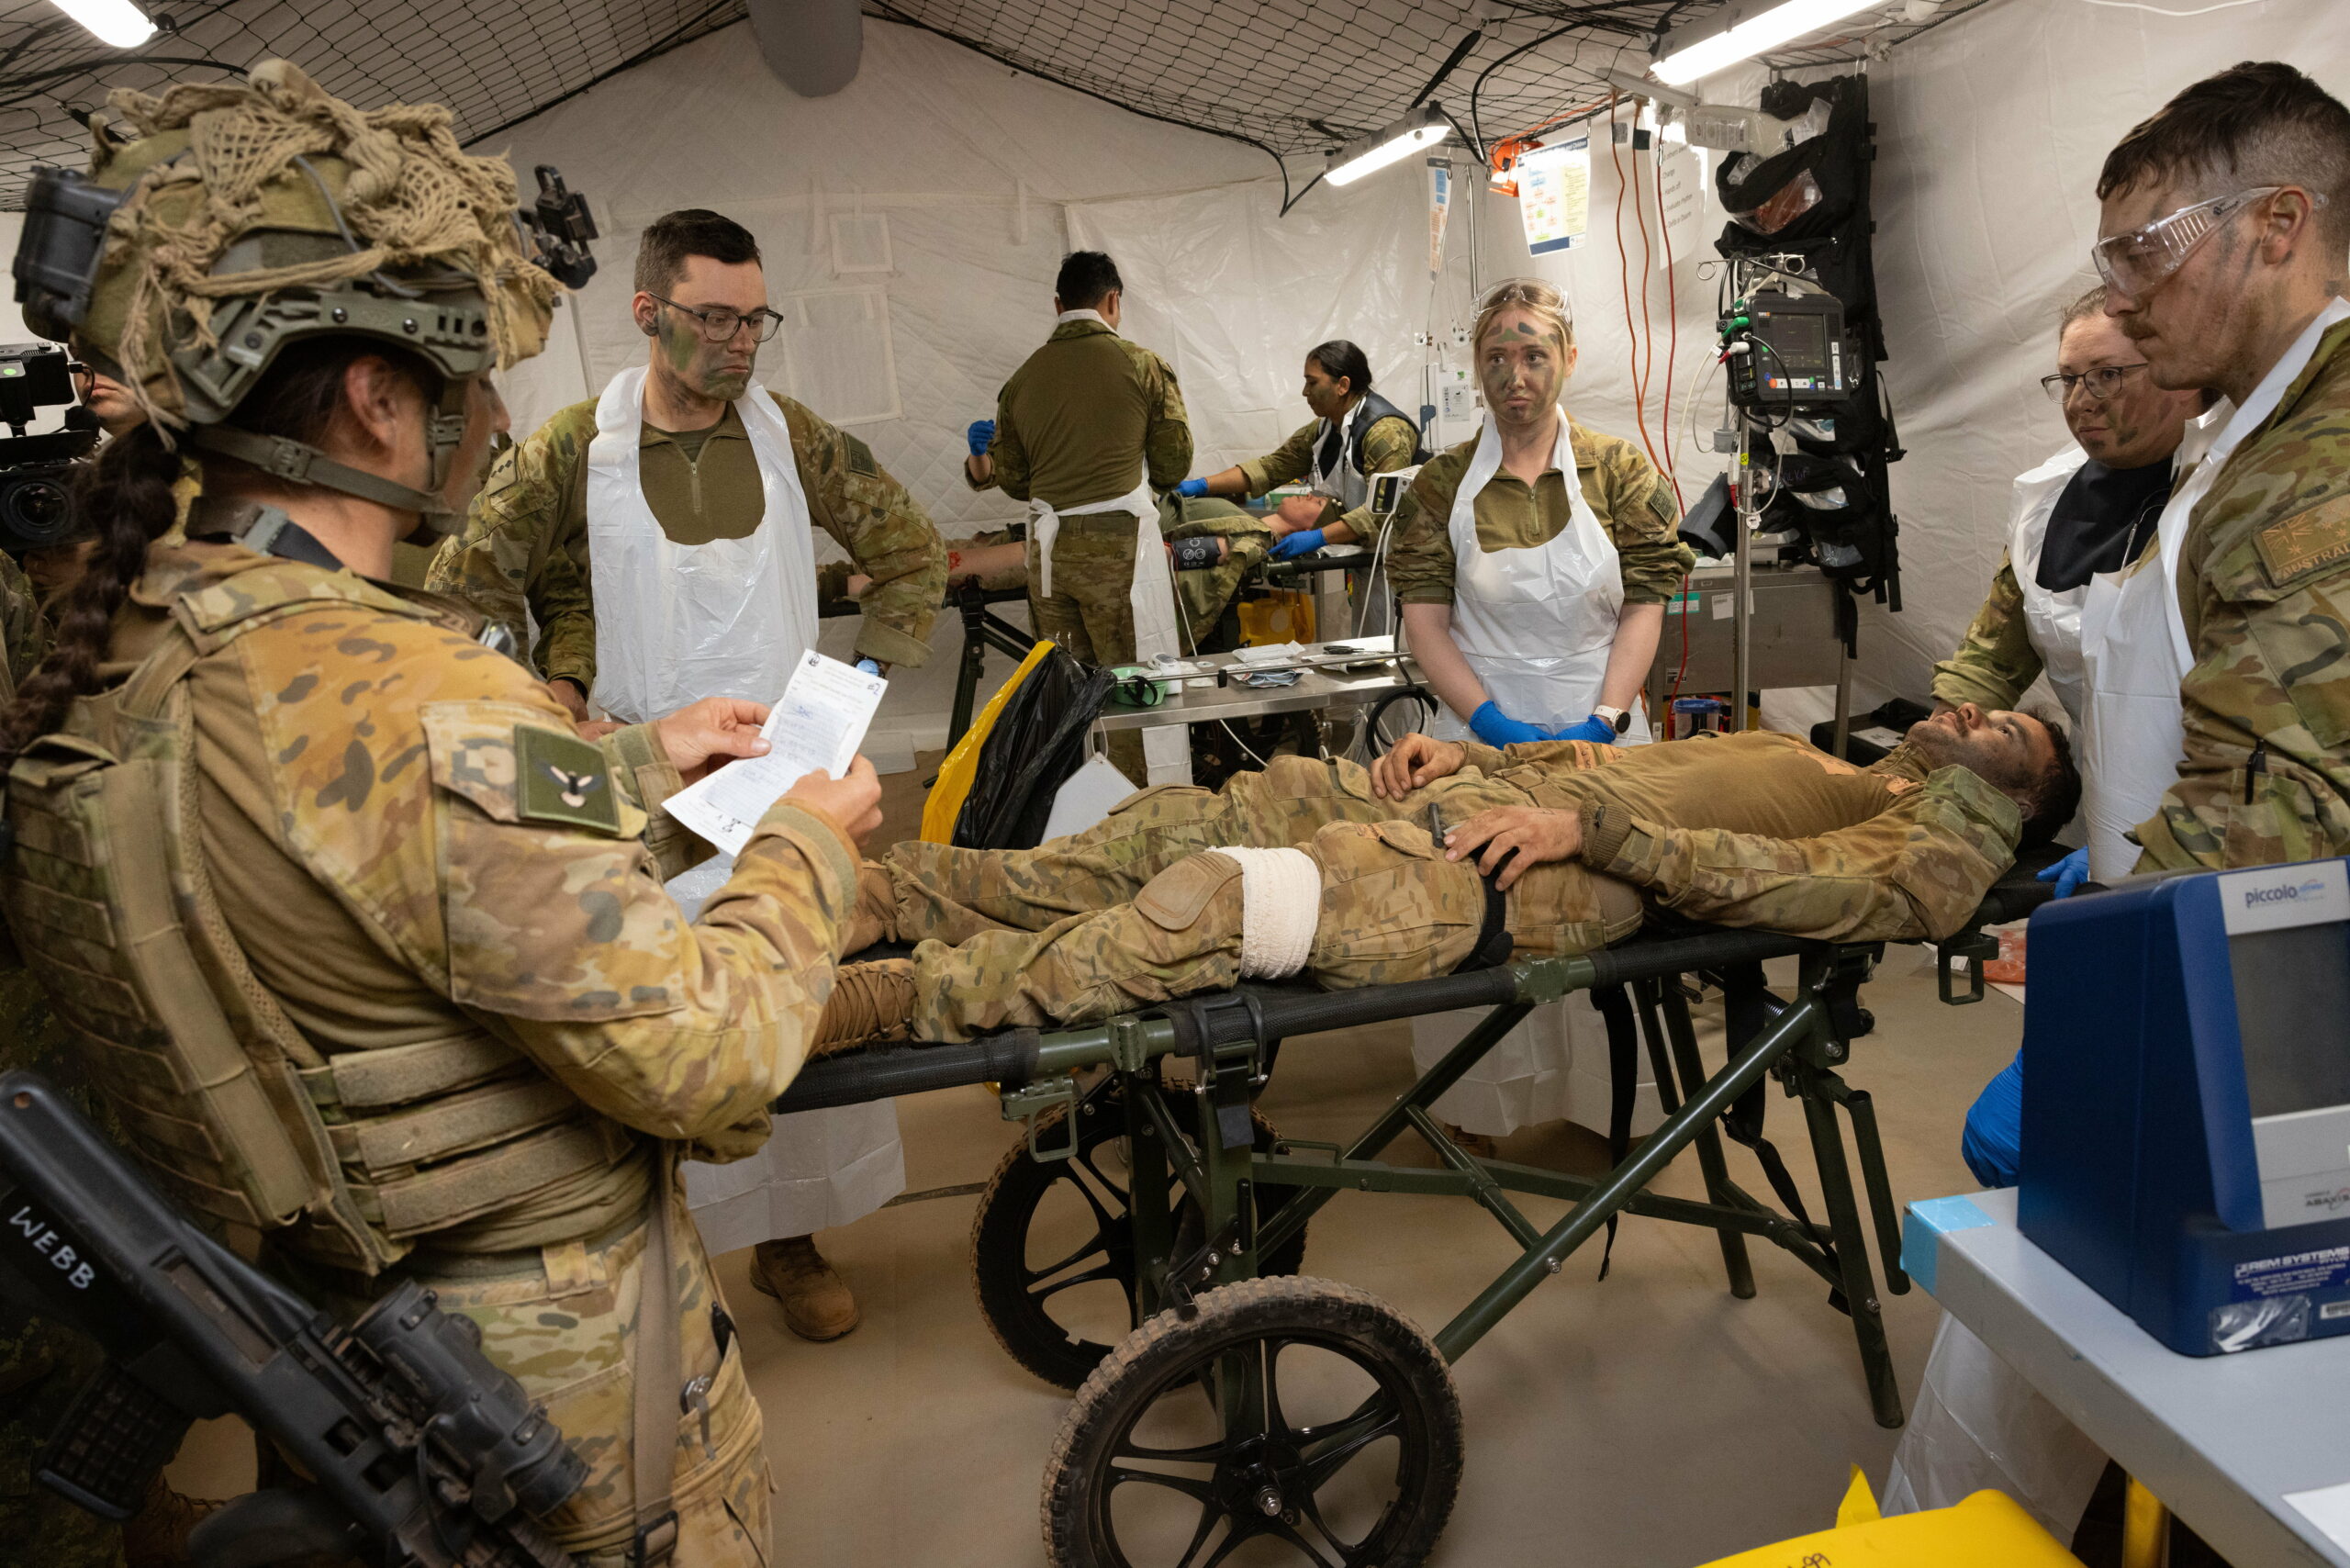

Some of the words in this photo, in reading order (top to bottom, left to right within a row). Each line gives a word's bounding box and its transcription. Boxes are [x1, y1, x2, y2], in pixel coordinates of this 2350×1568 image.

[2244, 884, 2298, 909] piccolo
[8, 1205, 95, 1289] WEBB
[2282, 1247, 2349, 1264] SYSTEMS
